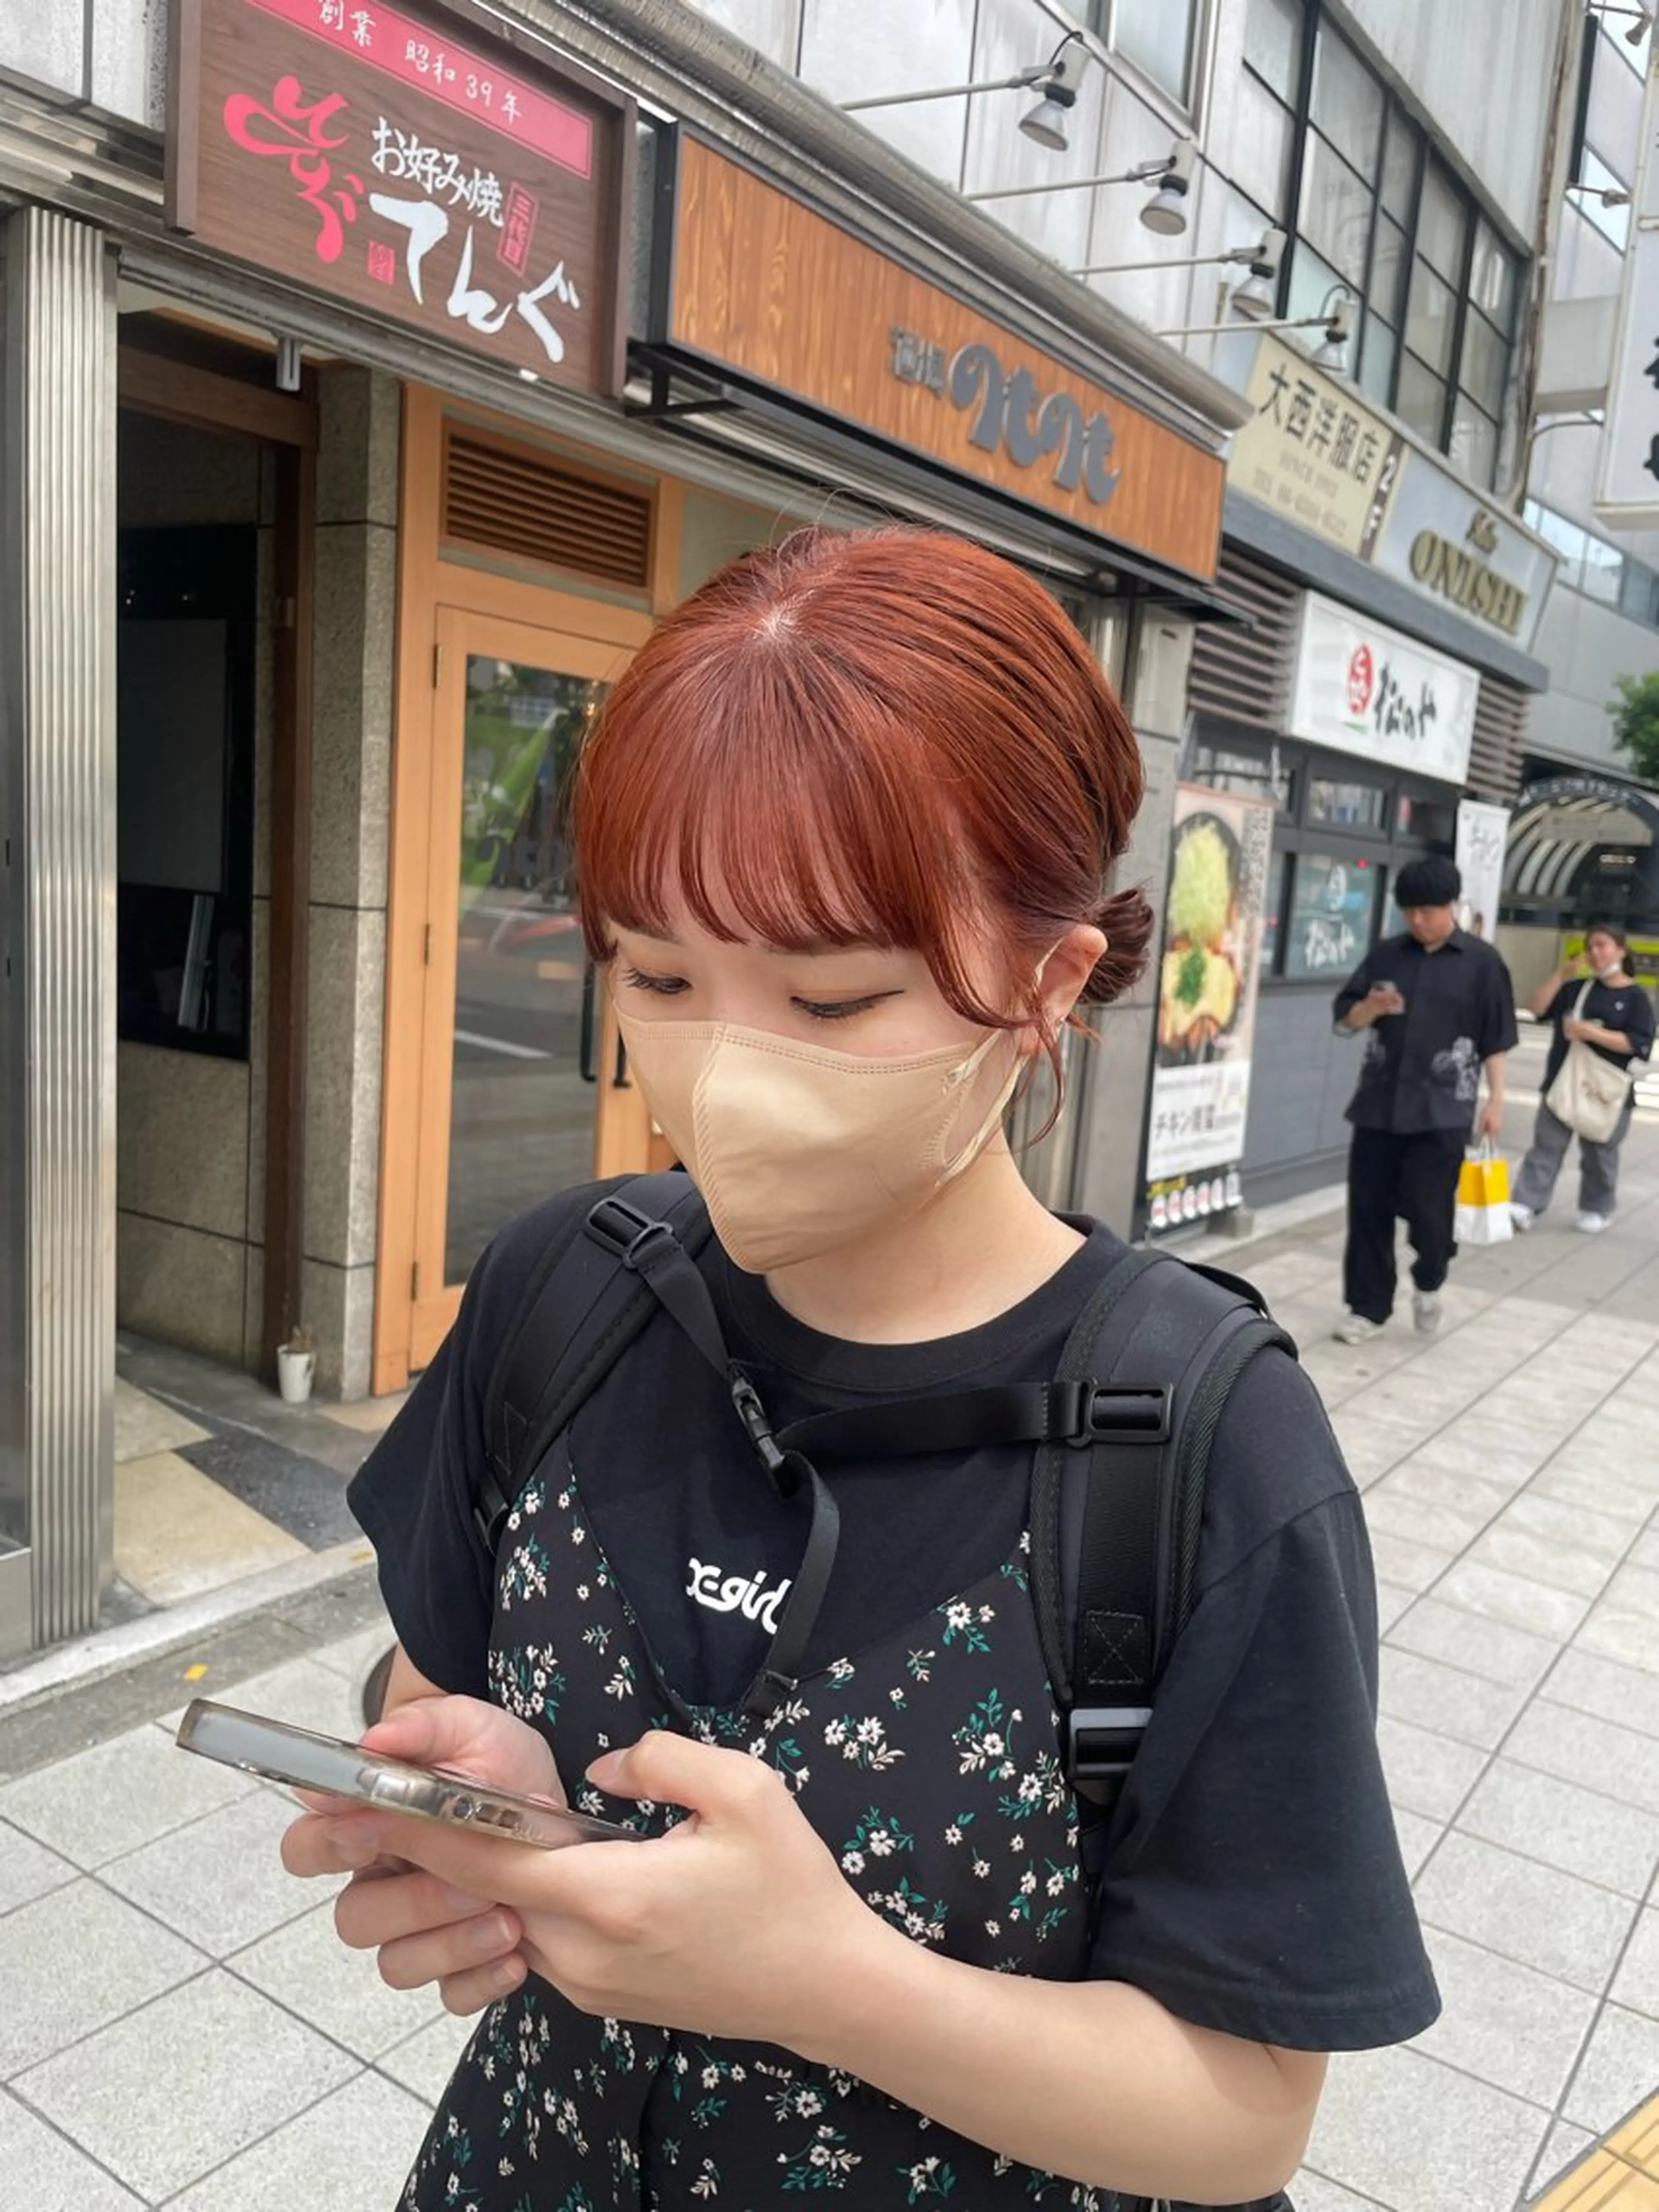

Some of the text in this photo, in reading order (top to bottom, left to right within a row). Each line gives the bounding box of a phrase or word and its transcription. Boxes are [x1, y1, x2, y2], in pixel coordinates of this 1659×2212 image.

[319, 0, 376, 46] 創業
[371, 117, 503, 226] お好み焼
[369, 193, 580, 362] てんぐ
[1259, 364, 1380, 483] 大西洋服店
[1409, 529, 1530, 636] ONISHI
